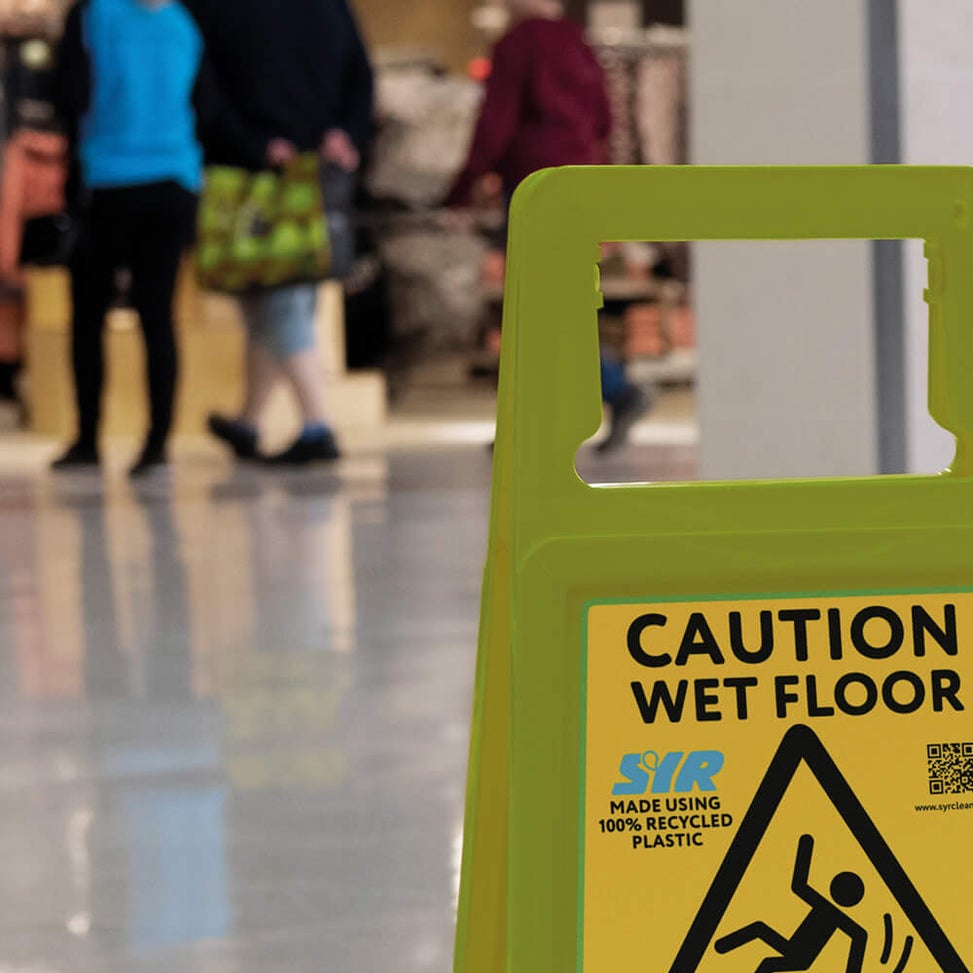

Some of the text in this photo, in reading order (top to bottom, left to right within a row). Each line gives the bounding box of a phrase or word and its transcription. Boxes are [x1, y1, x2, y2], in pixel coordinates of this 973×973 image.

[626, 603, 959, 669] CAUTION
[630, 668, 965, 725] WET FLOOR
[611, 750, 725, 796] SYR
[609, 796, 721, 815] MADE USING
[598, 813, 734, 833] 100% RECYCLED
[632, 832, 704, 849] PLASTIC
